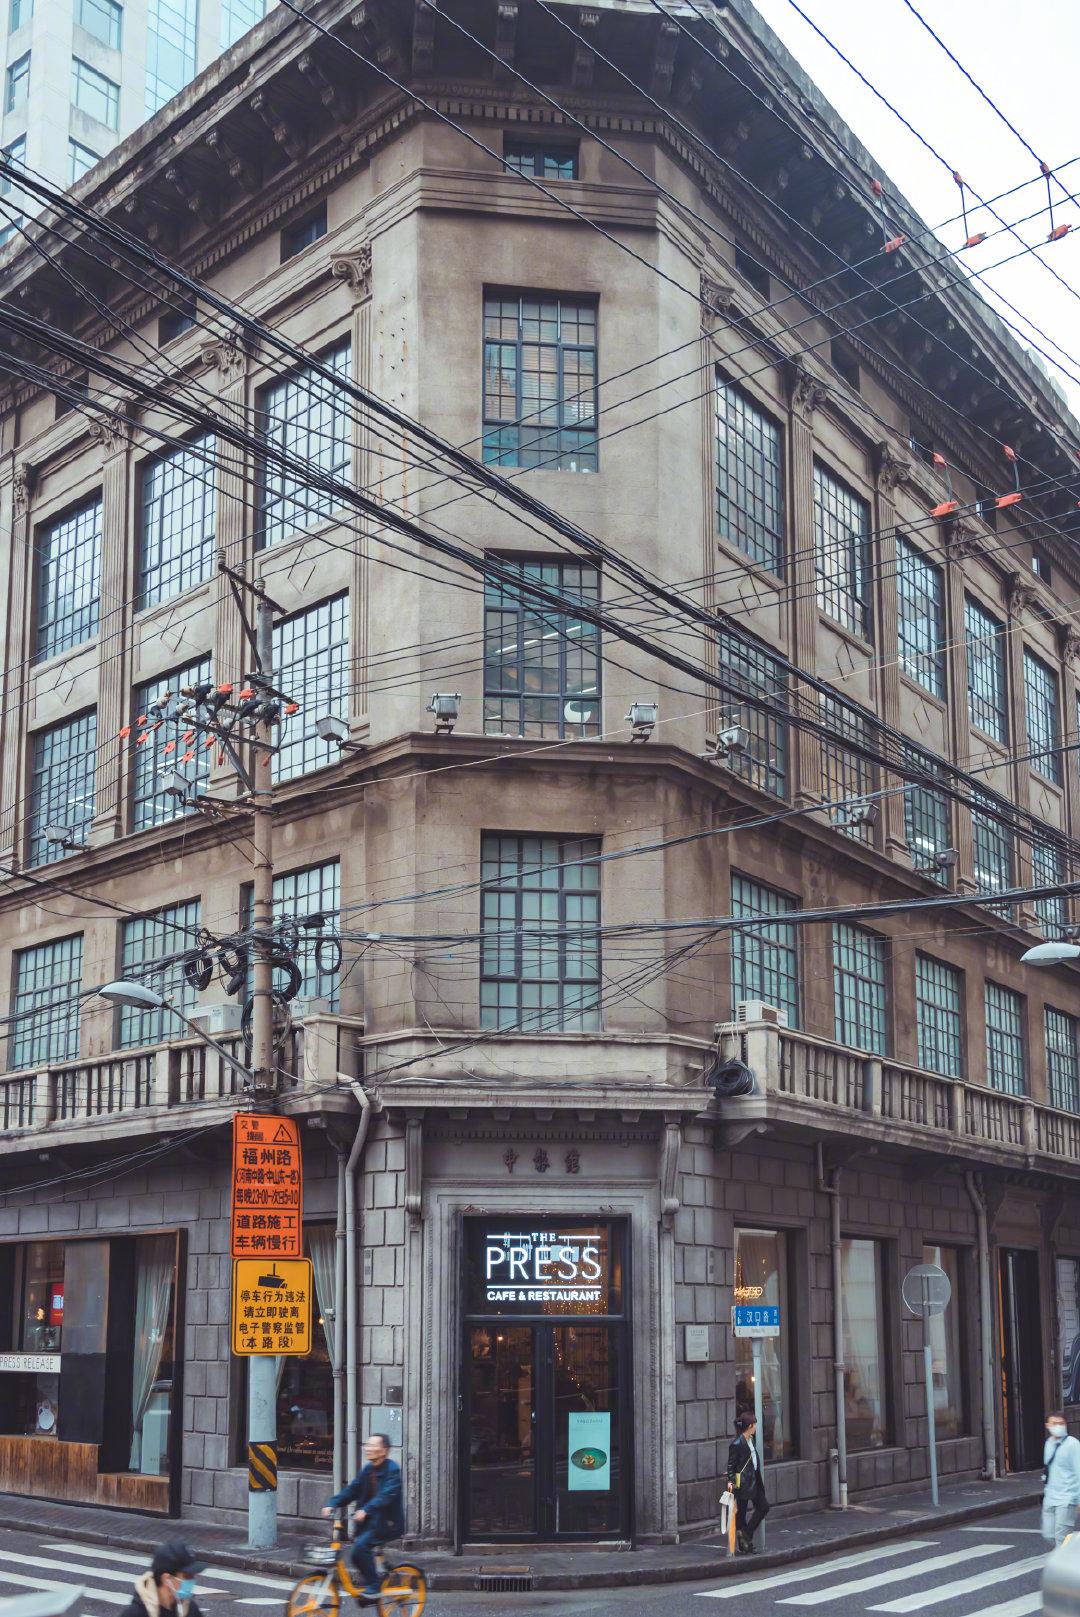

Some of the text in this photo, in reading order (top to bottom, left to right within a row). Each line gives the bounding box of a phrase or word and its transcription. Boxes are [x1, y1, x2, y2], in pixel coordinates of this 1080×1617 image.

[242, 1148, 291, 1166] 福州路
[236, 1215, 297, 1229] 道路施工
[235, 1235, 297, 1251] 车辆慢行
[531, 1232, 557, 1242] THE
[486, 1246, 602, 1280] PRESS
[240, 1290, 306, 1303] 停车行为违法
[486, 1291, 600, 1301] CAFE & RESTAURANT
[243, 1306, 300, 1319] 请立即驶离
[239, 1322, 305, 1335] 电子警察监管
[23, 1357, 54, 1370] RELEASE
